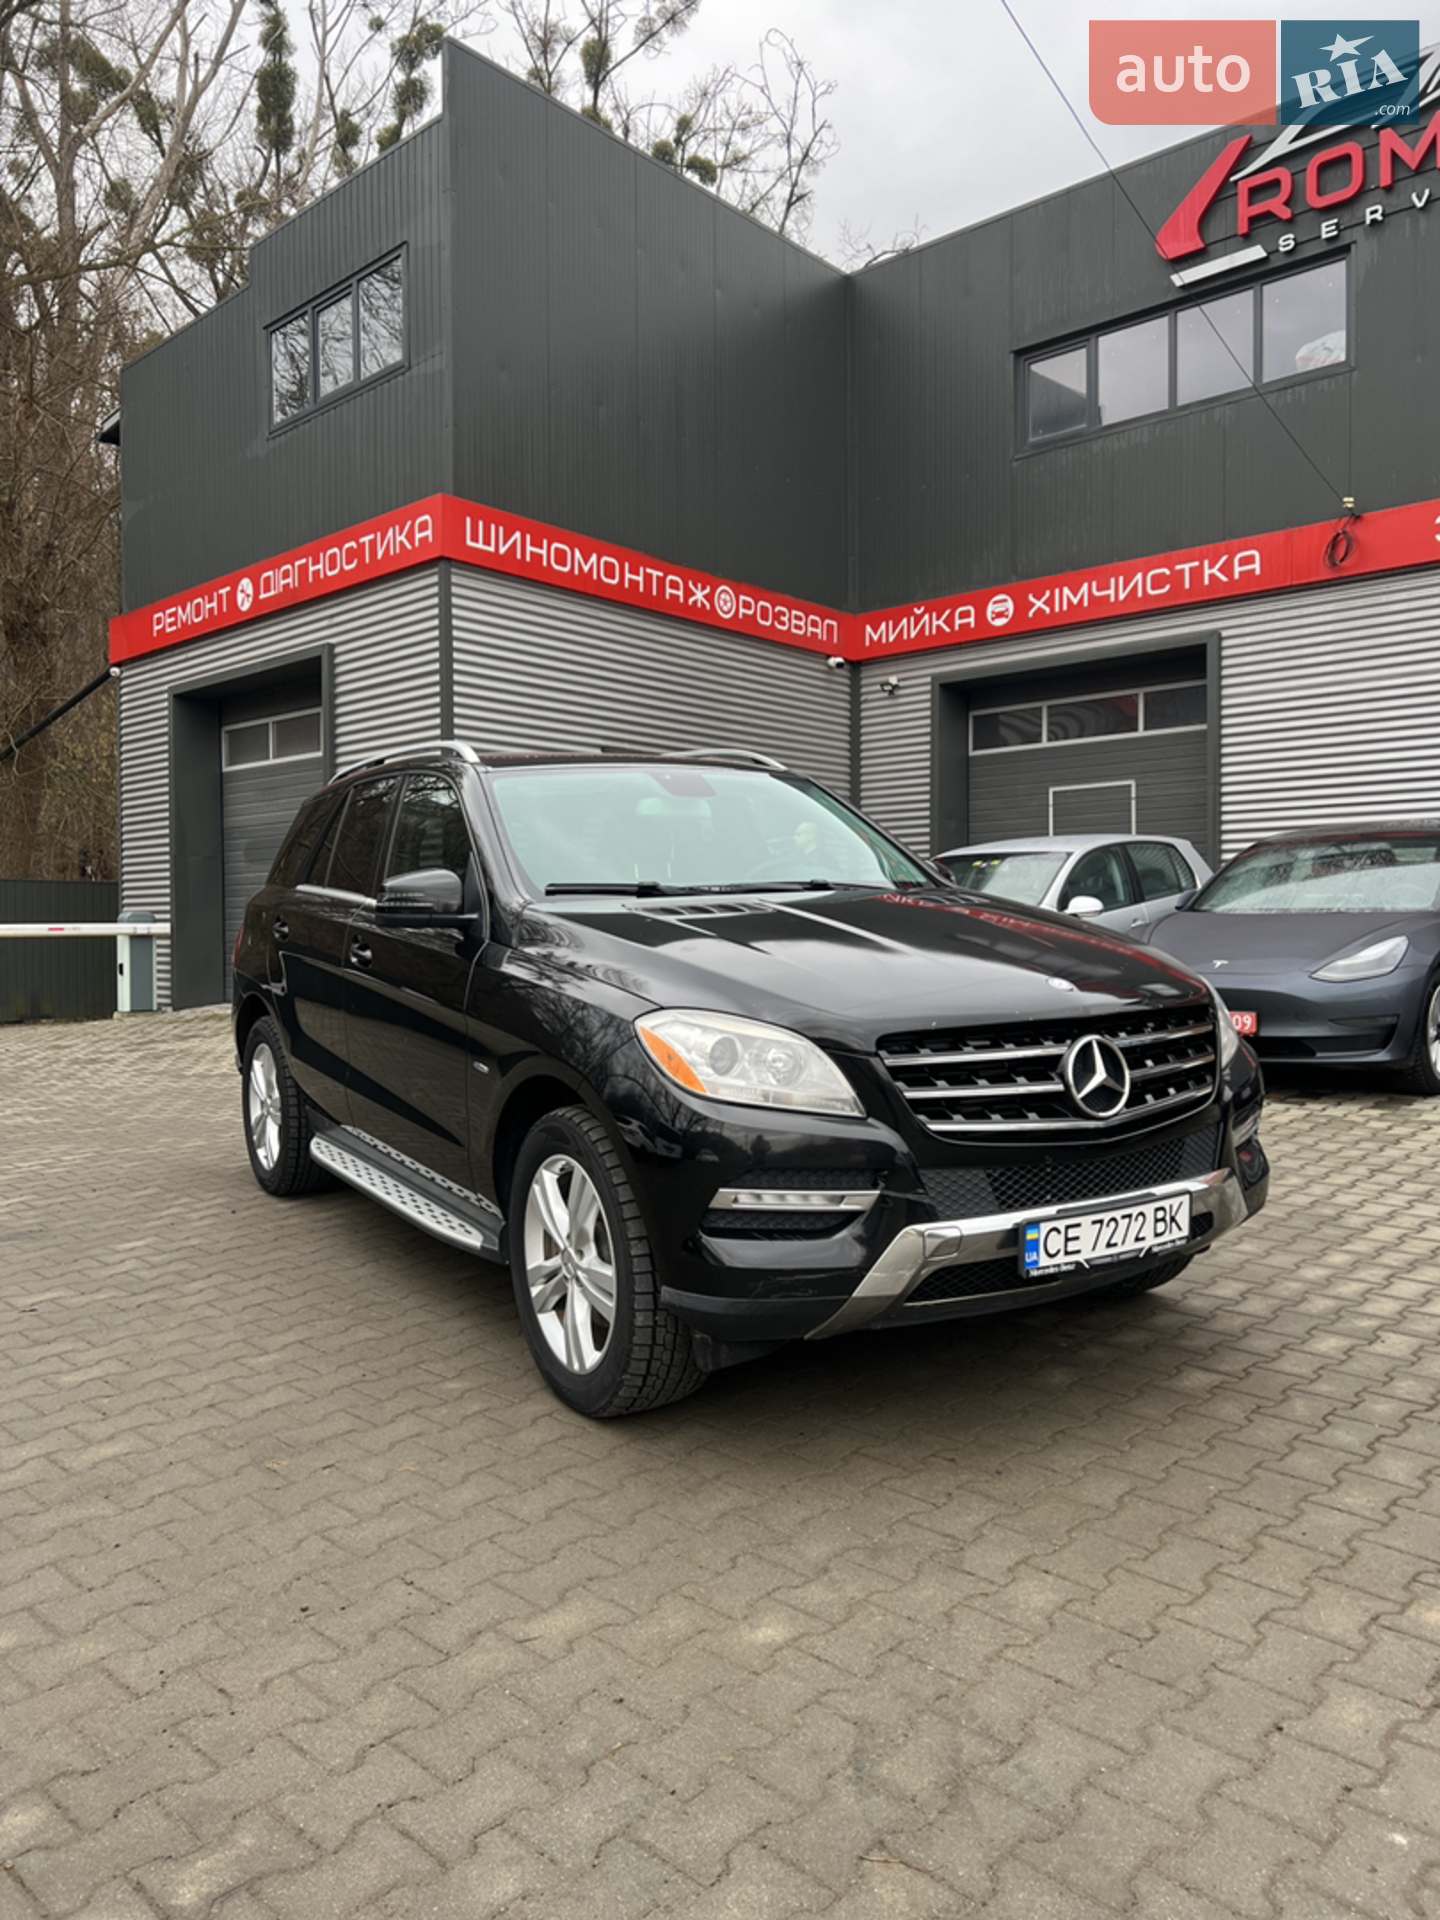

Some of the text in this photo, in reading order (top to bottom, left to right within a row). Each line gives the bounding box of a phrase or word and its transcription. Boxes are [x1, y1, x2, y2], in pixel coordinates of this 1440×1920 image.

[1278, 187, 1431, 253] SERV
[152, 513, 434, 637] РЕМОНТ ДІАГНОСТИКА
[465, 515, 711, 612] ШИНОМОНТАЖ
[864, 549, 1262, 647] МИЙКА ХІМЧИСТКА
[1043, 1202, 1183, 1258] CE 7272 BK
